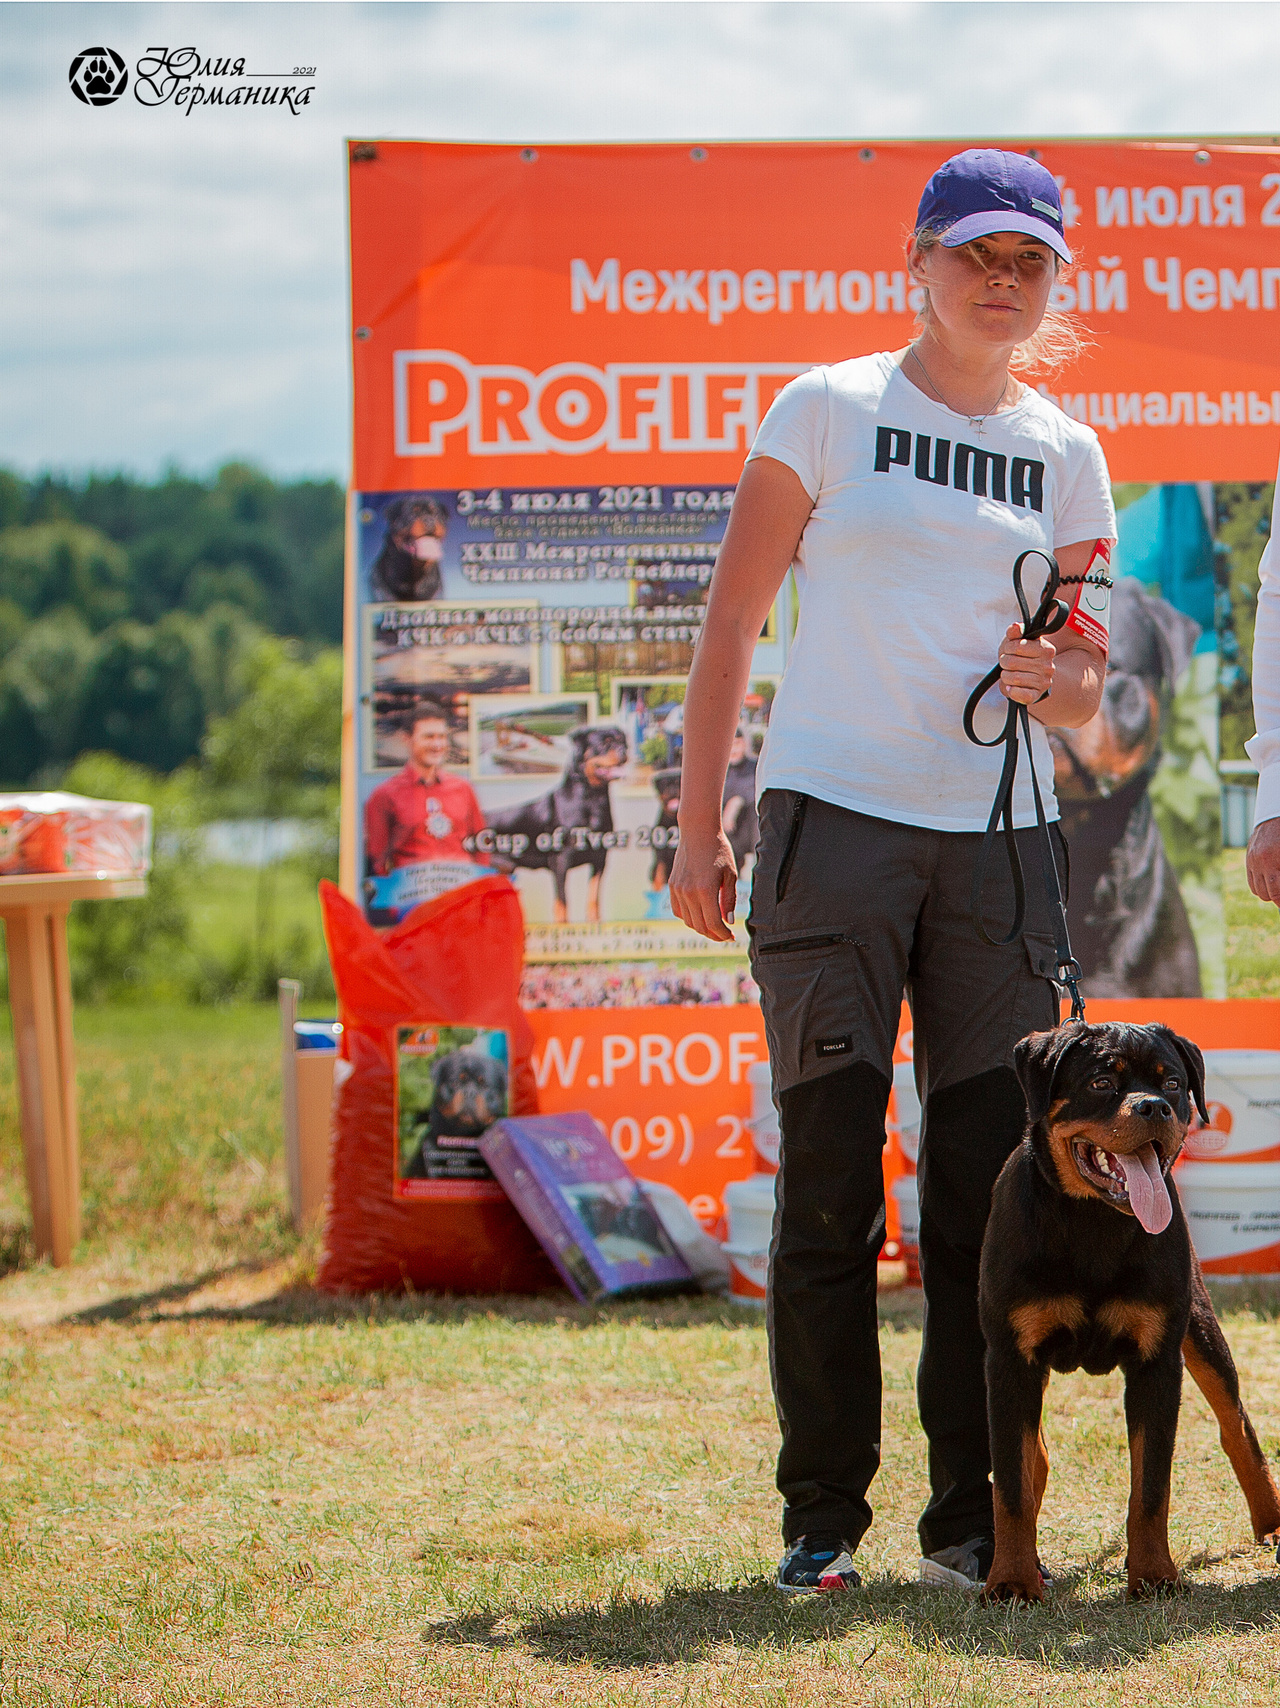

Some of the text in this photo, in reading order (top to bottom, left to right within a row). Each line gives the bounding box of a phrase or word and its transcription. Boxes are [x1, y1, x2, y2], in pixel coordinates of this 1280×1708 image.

[1096, 186, 1245, 229] июля
[874, 426, 1045, 513] PUMA
[457, 487, 735, 515] 3-4 июля 2021 года
[463, 561, 717, 584] Чемпионат Ротвейлер
[381, 607, 478, 630] Двойная
[653, 604, 707, 621] выст
[640, 625, 702, 645] стату
[462, 825, 680, 857] «Cup of Tver 202
[531, 1032, 759, 1089] W.PROF
[595, 1113, 694, 1166] 09)
